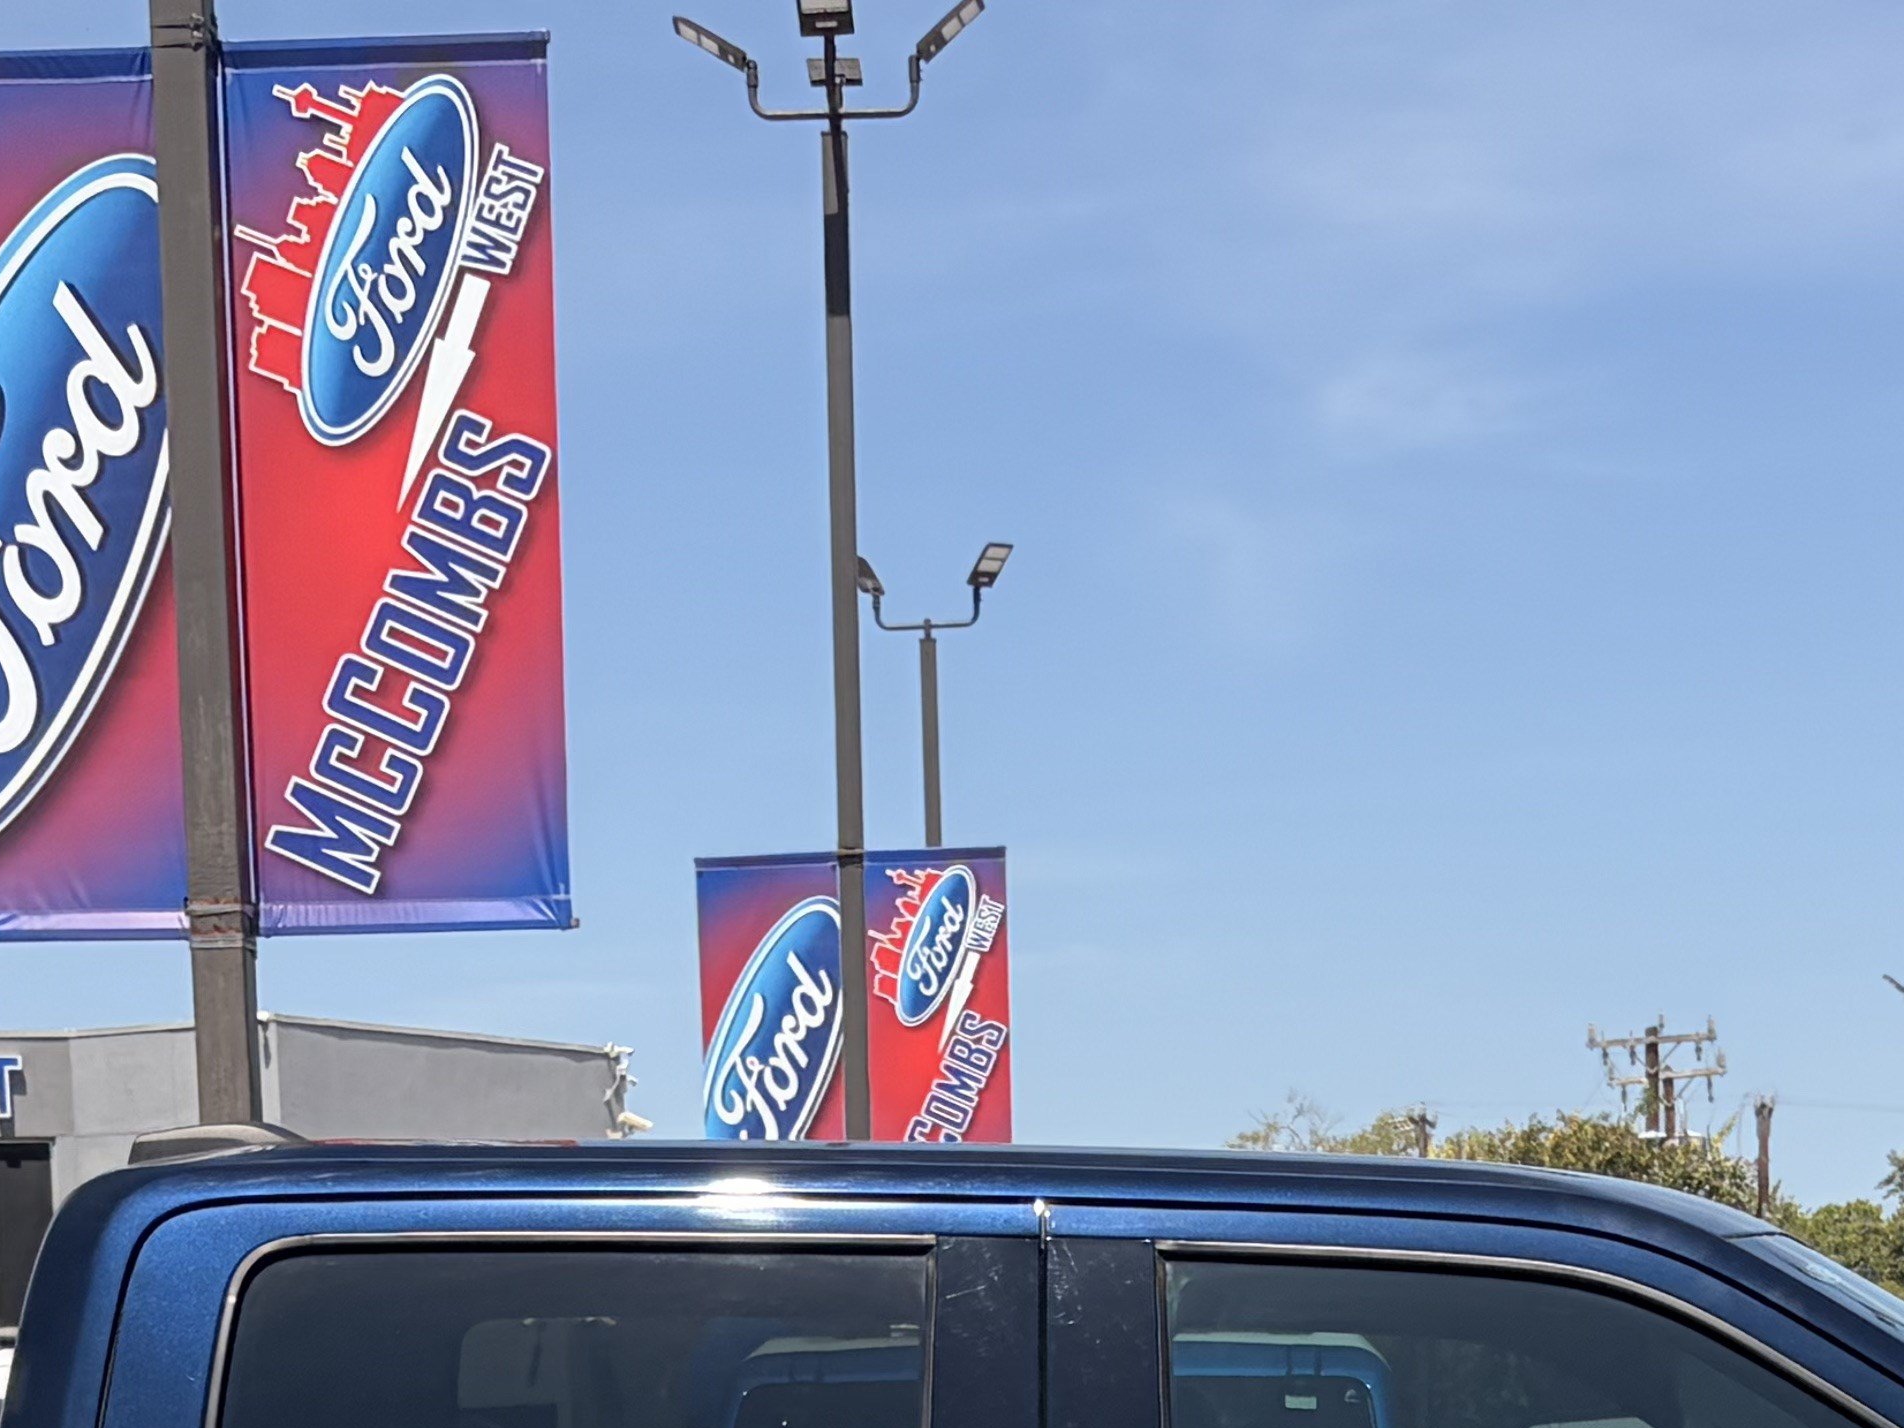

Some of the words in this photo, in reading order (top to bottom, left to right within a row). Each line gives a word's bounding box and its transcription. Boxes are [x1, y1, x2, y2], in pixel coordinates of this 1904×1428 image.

[324, 146, 452, 378] Ford
[459, 141, 545, 276] WEST
[906, 896, 964, 998] Ford
[965, 893, 1005, 952] WEST
[713, 950, 835, 1141] Ford
